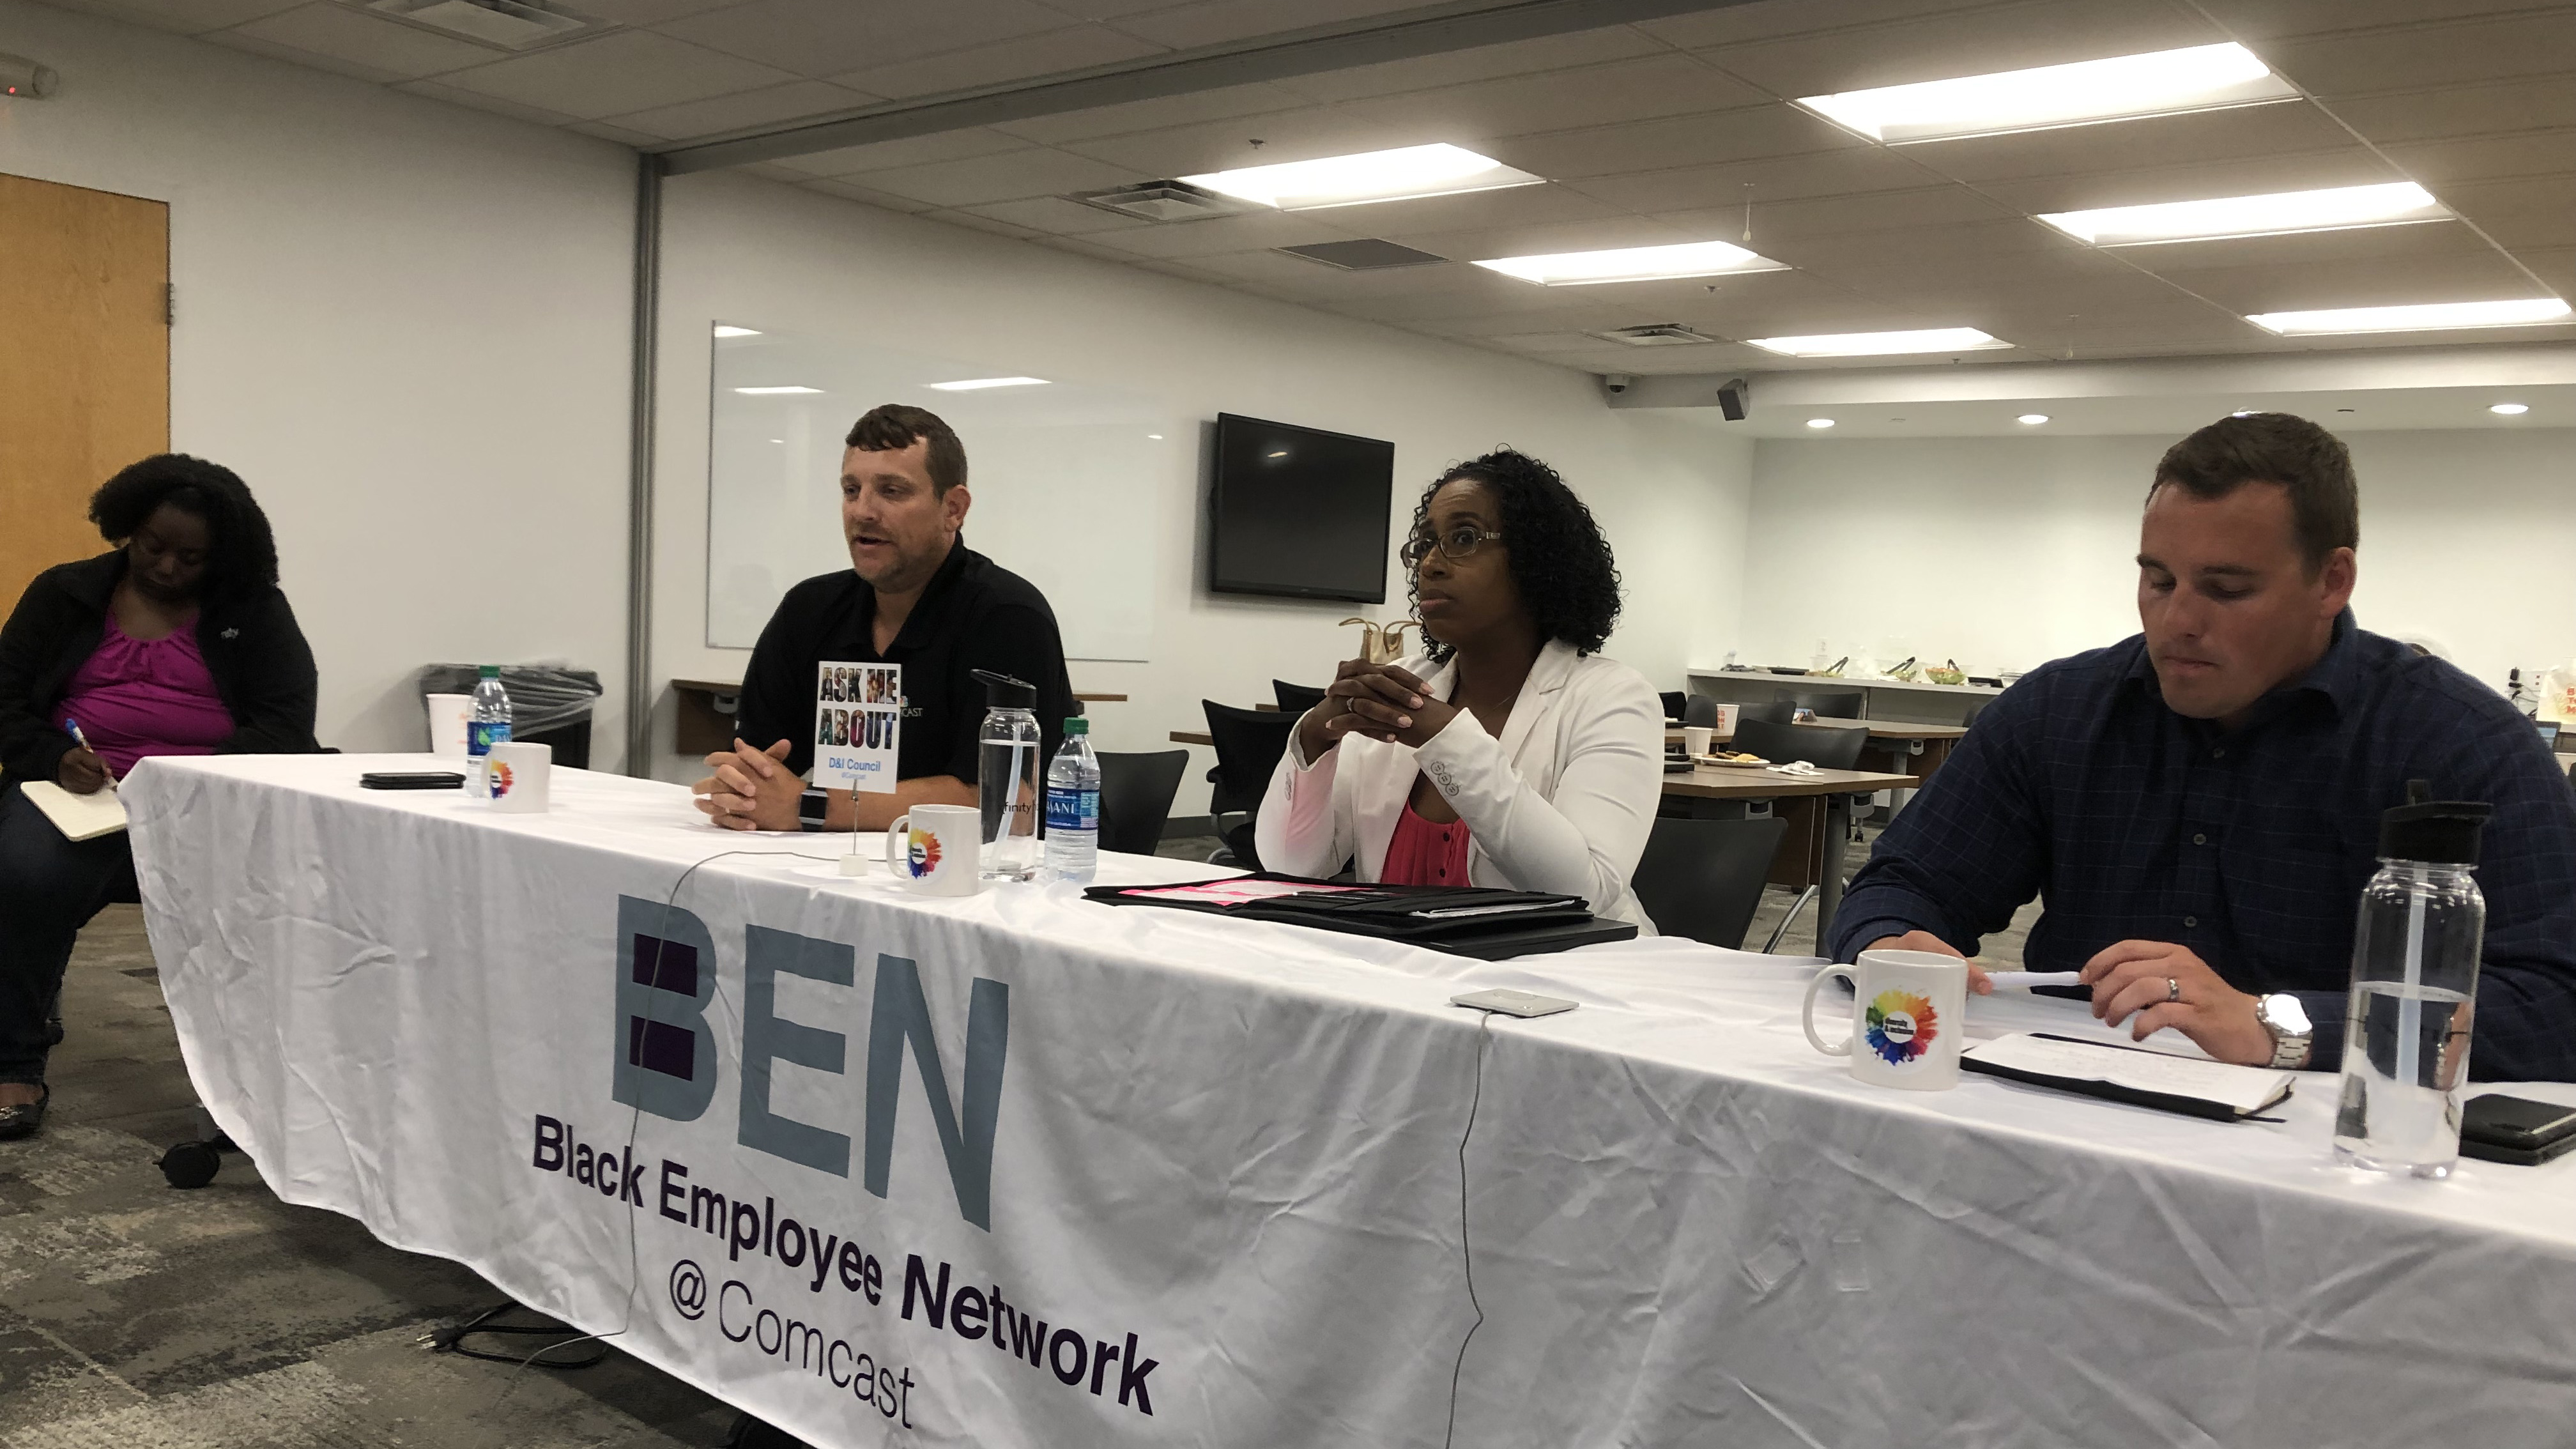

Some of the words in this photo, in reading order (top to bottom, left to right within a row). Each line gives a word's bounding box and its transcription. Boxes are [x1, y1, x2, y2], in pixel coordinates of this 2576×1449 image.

[820, 667, 862, 703] ASK
[866, 668, 897, 704] ME
[818, 708, 897, 749] ABOUT
[900, 707, 924, 717] CAST
[829, 756, 845, 769] D&I
[847, 758, 881, 772] Council
[1002, 801, 1032, 815] finity
[613, 894, 1009, 1233] BEN
[533, 1114, 645, 1208] Black
[659, 1158, 883, 1307] Employee
[900, 1253, 1161, 1416] Network
[719, 1280, 916, 1430] Comcast
